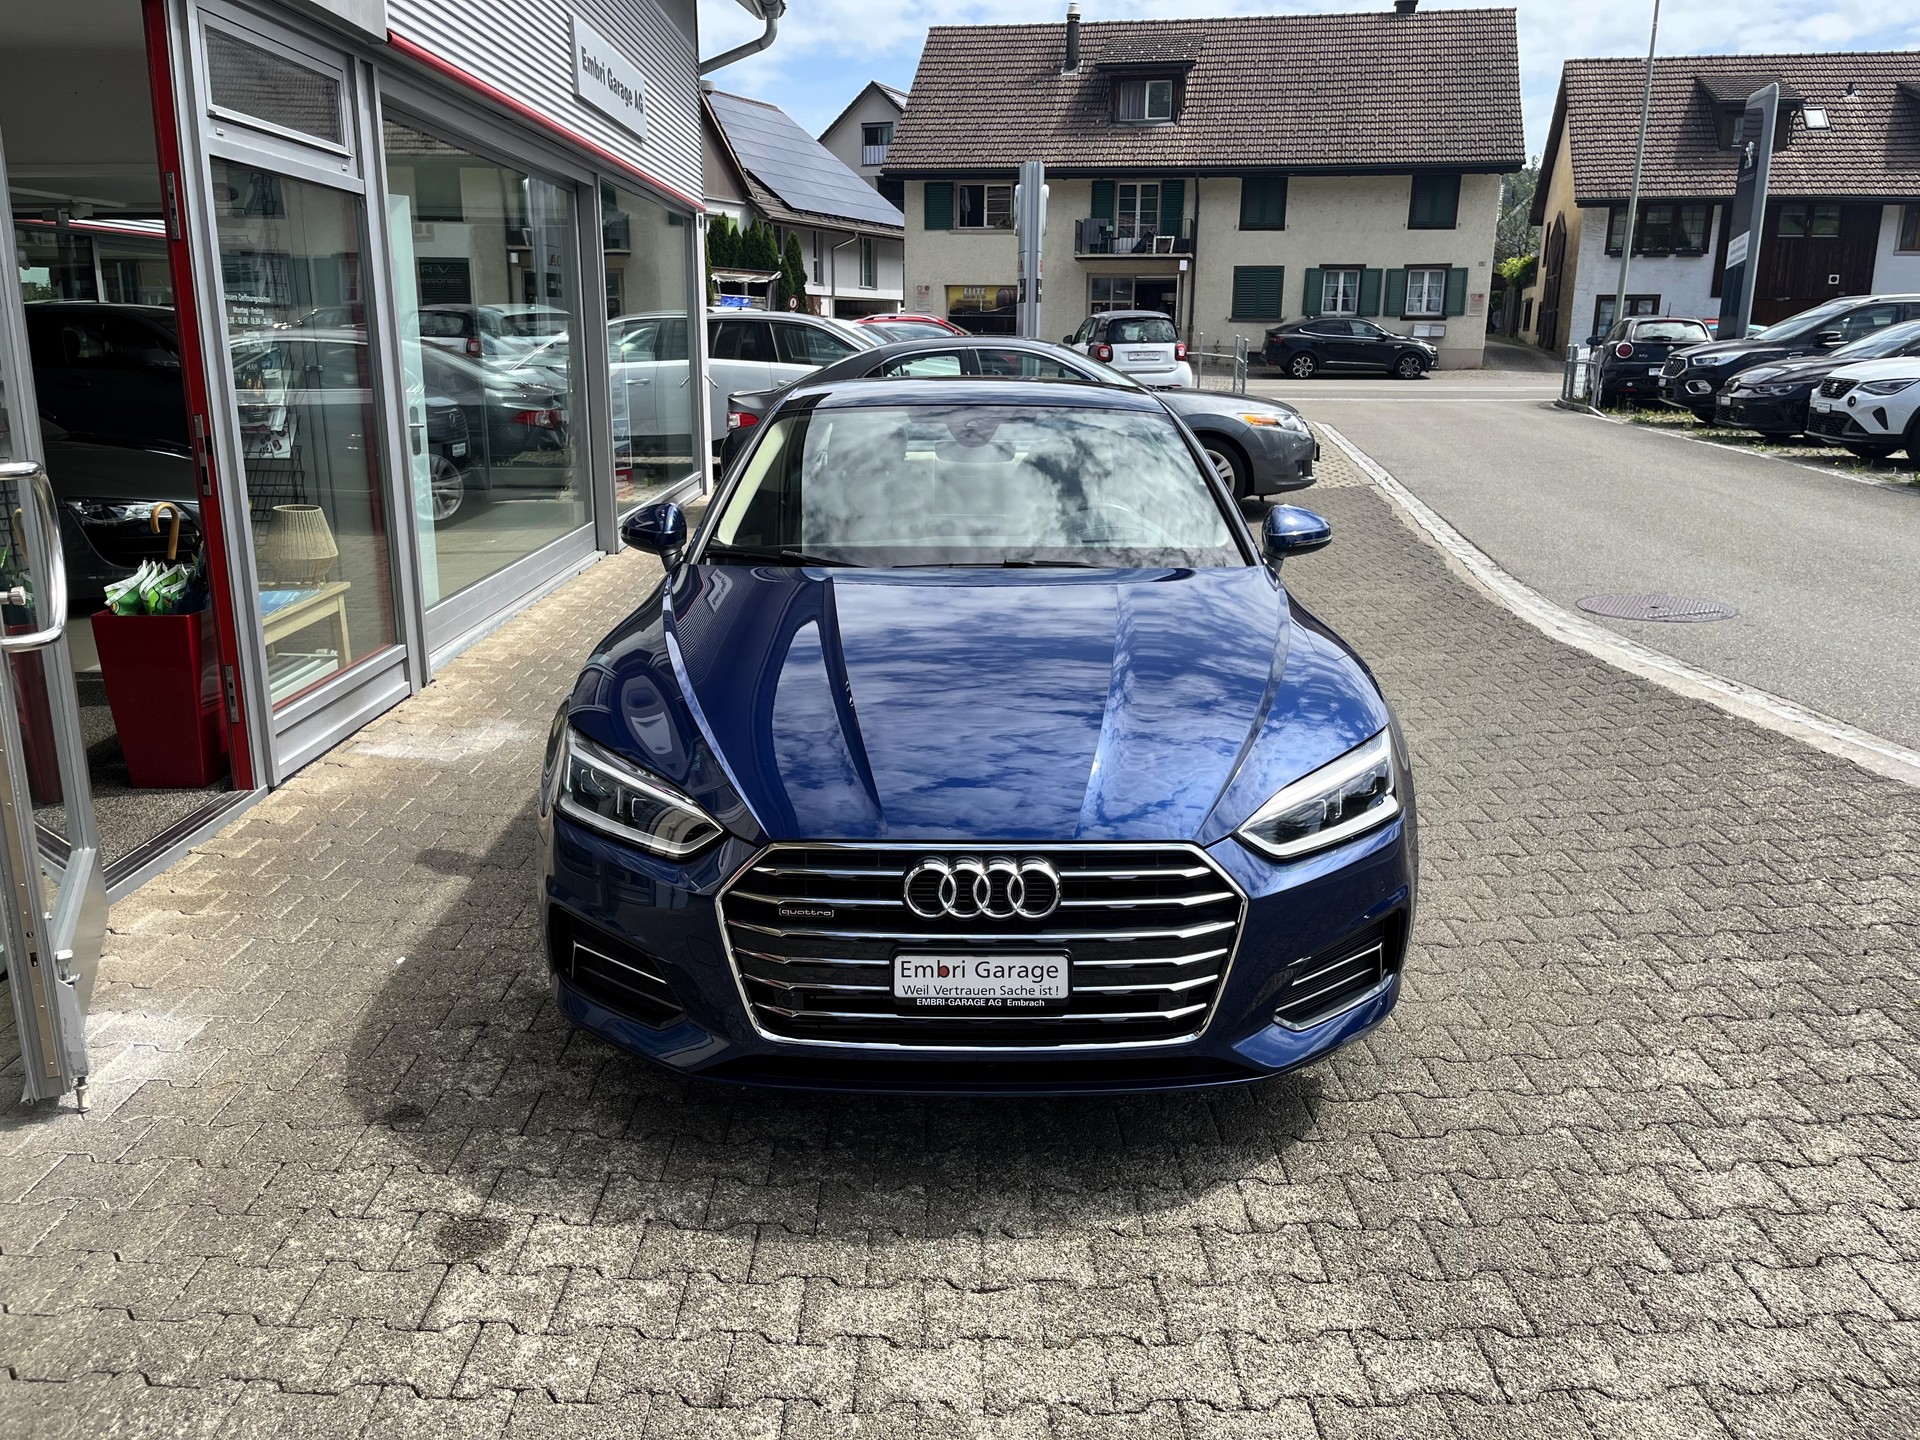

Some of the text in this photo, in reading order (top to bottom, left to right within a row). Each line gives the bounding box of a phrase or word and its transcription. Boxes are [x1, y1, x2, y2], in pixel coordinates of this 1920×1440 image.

[581, 45, 644, 114] Embri Garage AG
[233, 306, 248, 315] Montag
[780, 908, 832, 916] quattro
[900, 959, 1059, 984] Embri Garage
[902, 984, 929, 996] Weil
[933, 985, 996, 996] Vertrauen
[999, 985, 1036, 996] Sache
[916, 998, 1045, 1008] EMBRI-GARAGE AG Embrach
